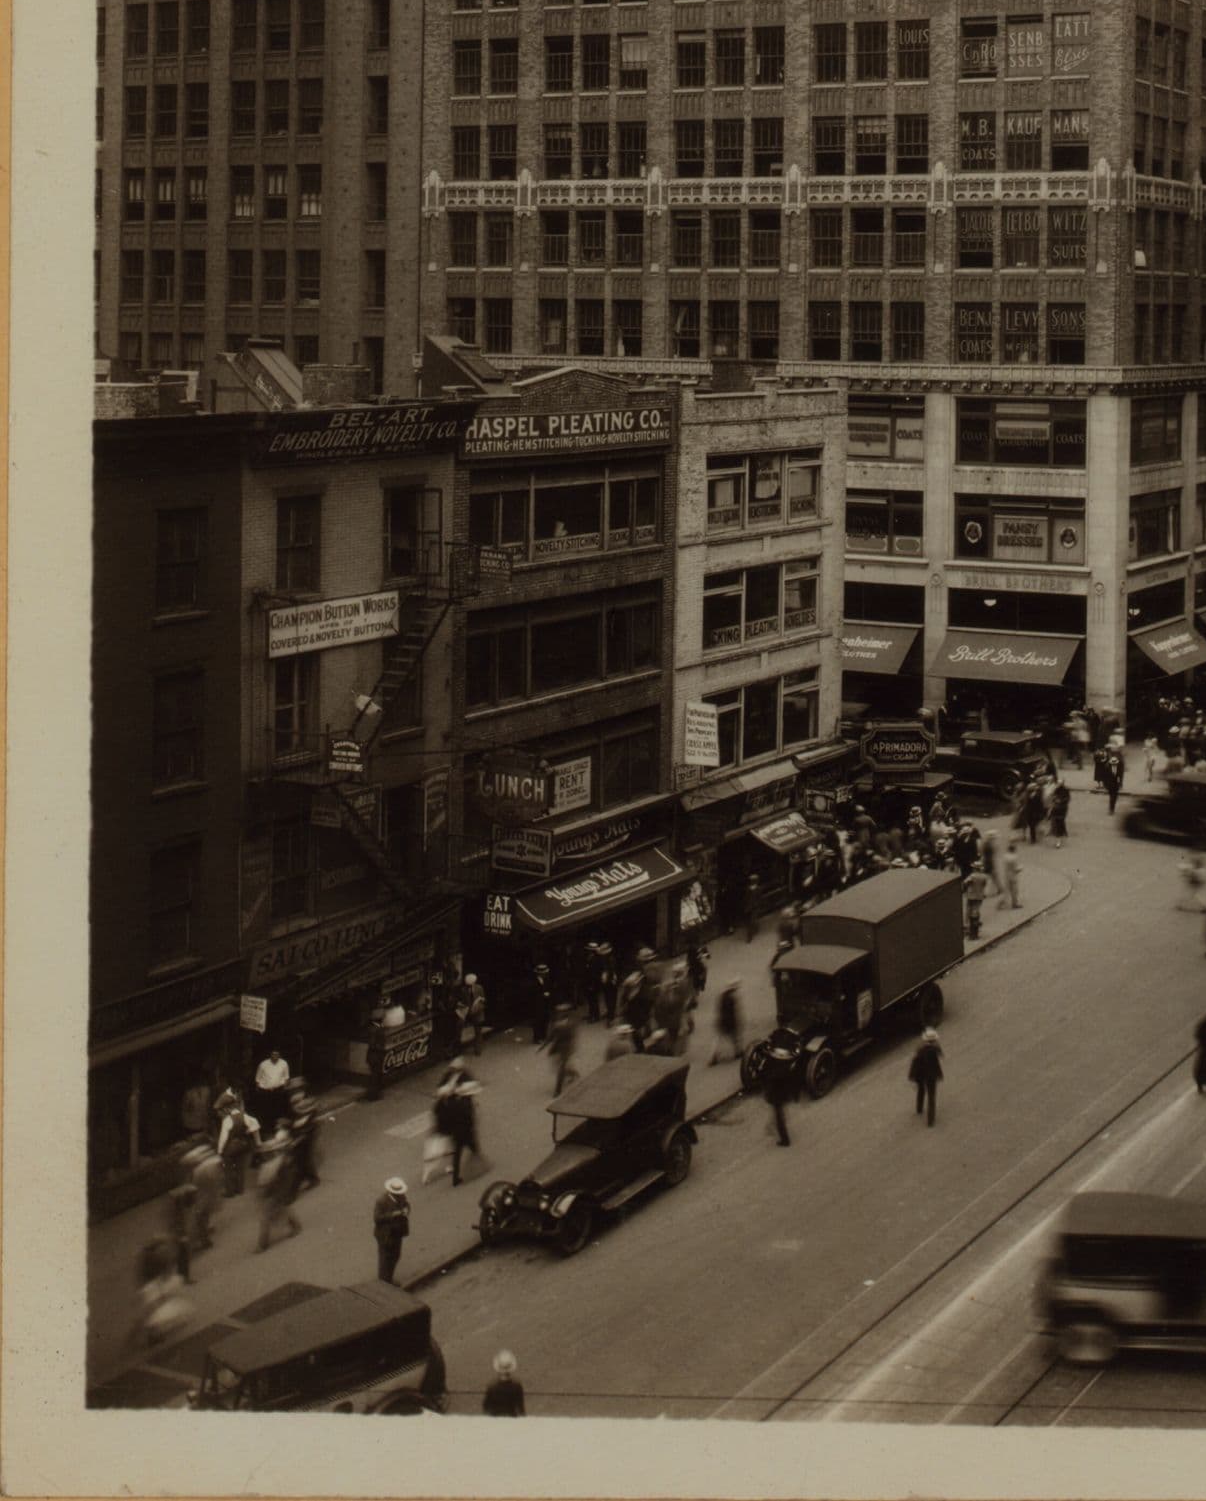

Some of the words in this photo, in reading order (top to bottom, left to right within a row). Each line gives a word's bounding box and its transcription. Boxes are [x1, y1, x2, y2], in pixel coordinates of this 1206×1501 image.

[962, 147, 996, 161] COATS
[329, 408, 434, 429] BEL-ART
[465, 416, 539, 440] HASPEL
[548, 411, 634, 436] PLEATING
[639, 409, 664, 429] CO.
[269, 427, 374, 453] EMBROIDERY
[373, 421, 437, 445] NOVELTY
[1056, 433, 1086, 444] COATS
[964, 574, 999, 588] BRILL
[1005, 576, 1073, 592] BROTHERS
[271, 609, 322, 630] CHAMPION
[324, 601, 360, 621] BUTTON
[363, 596, 396, 613] WORKS
[316, 628, 350, 643] NOVELTY
[949, 645, 990, 662] Brill
[990, 649, 1058, 667] Brothers
[878, 740, 928, 754] PRIMADORA
[478, 770, 545, 804] LUNCH
[559, 771, 586, 791] RENT
[487, 894, 511, 912] EAT
[483, 910, 513, 930] DRINK
